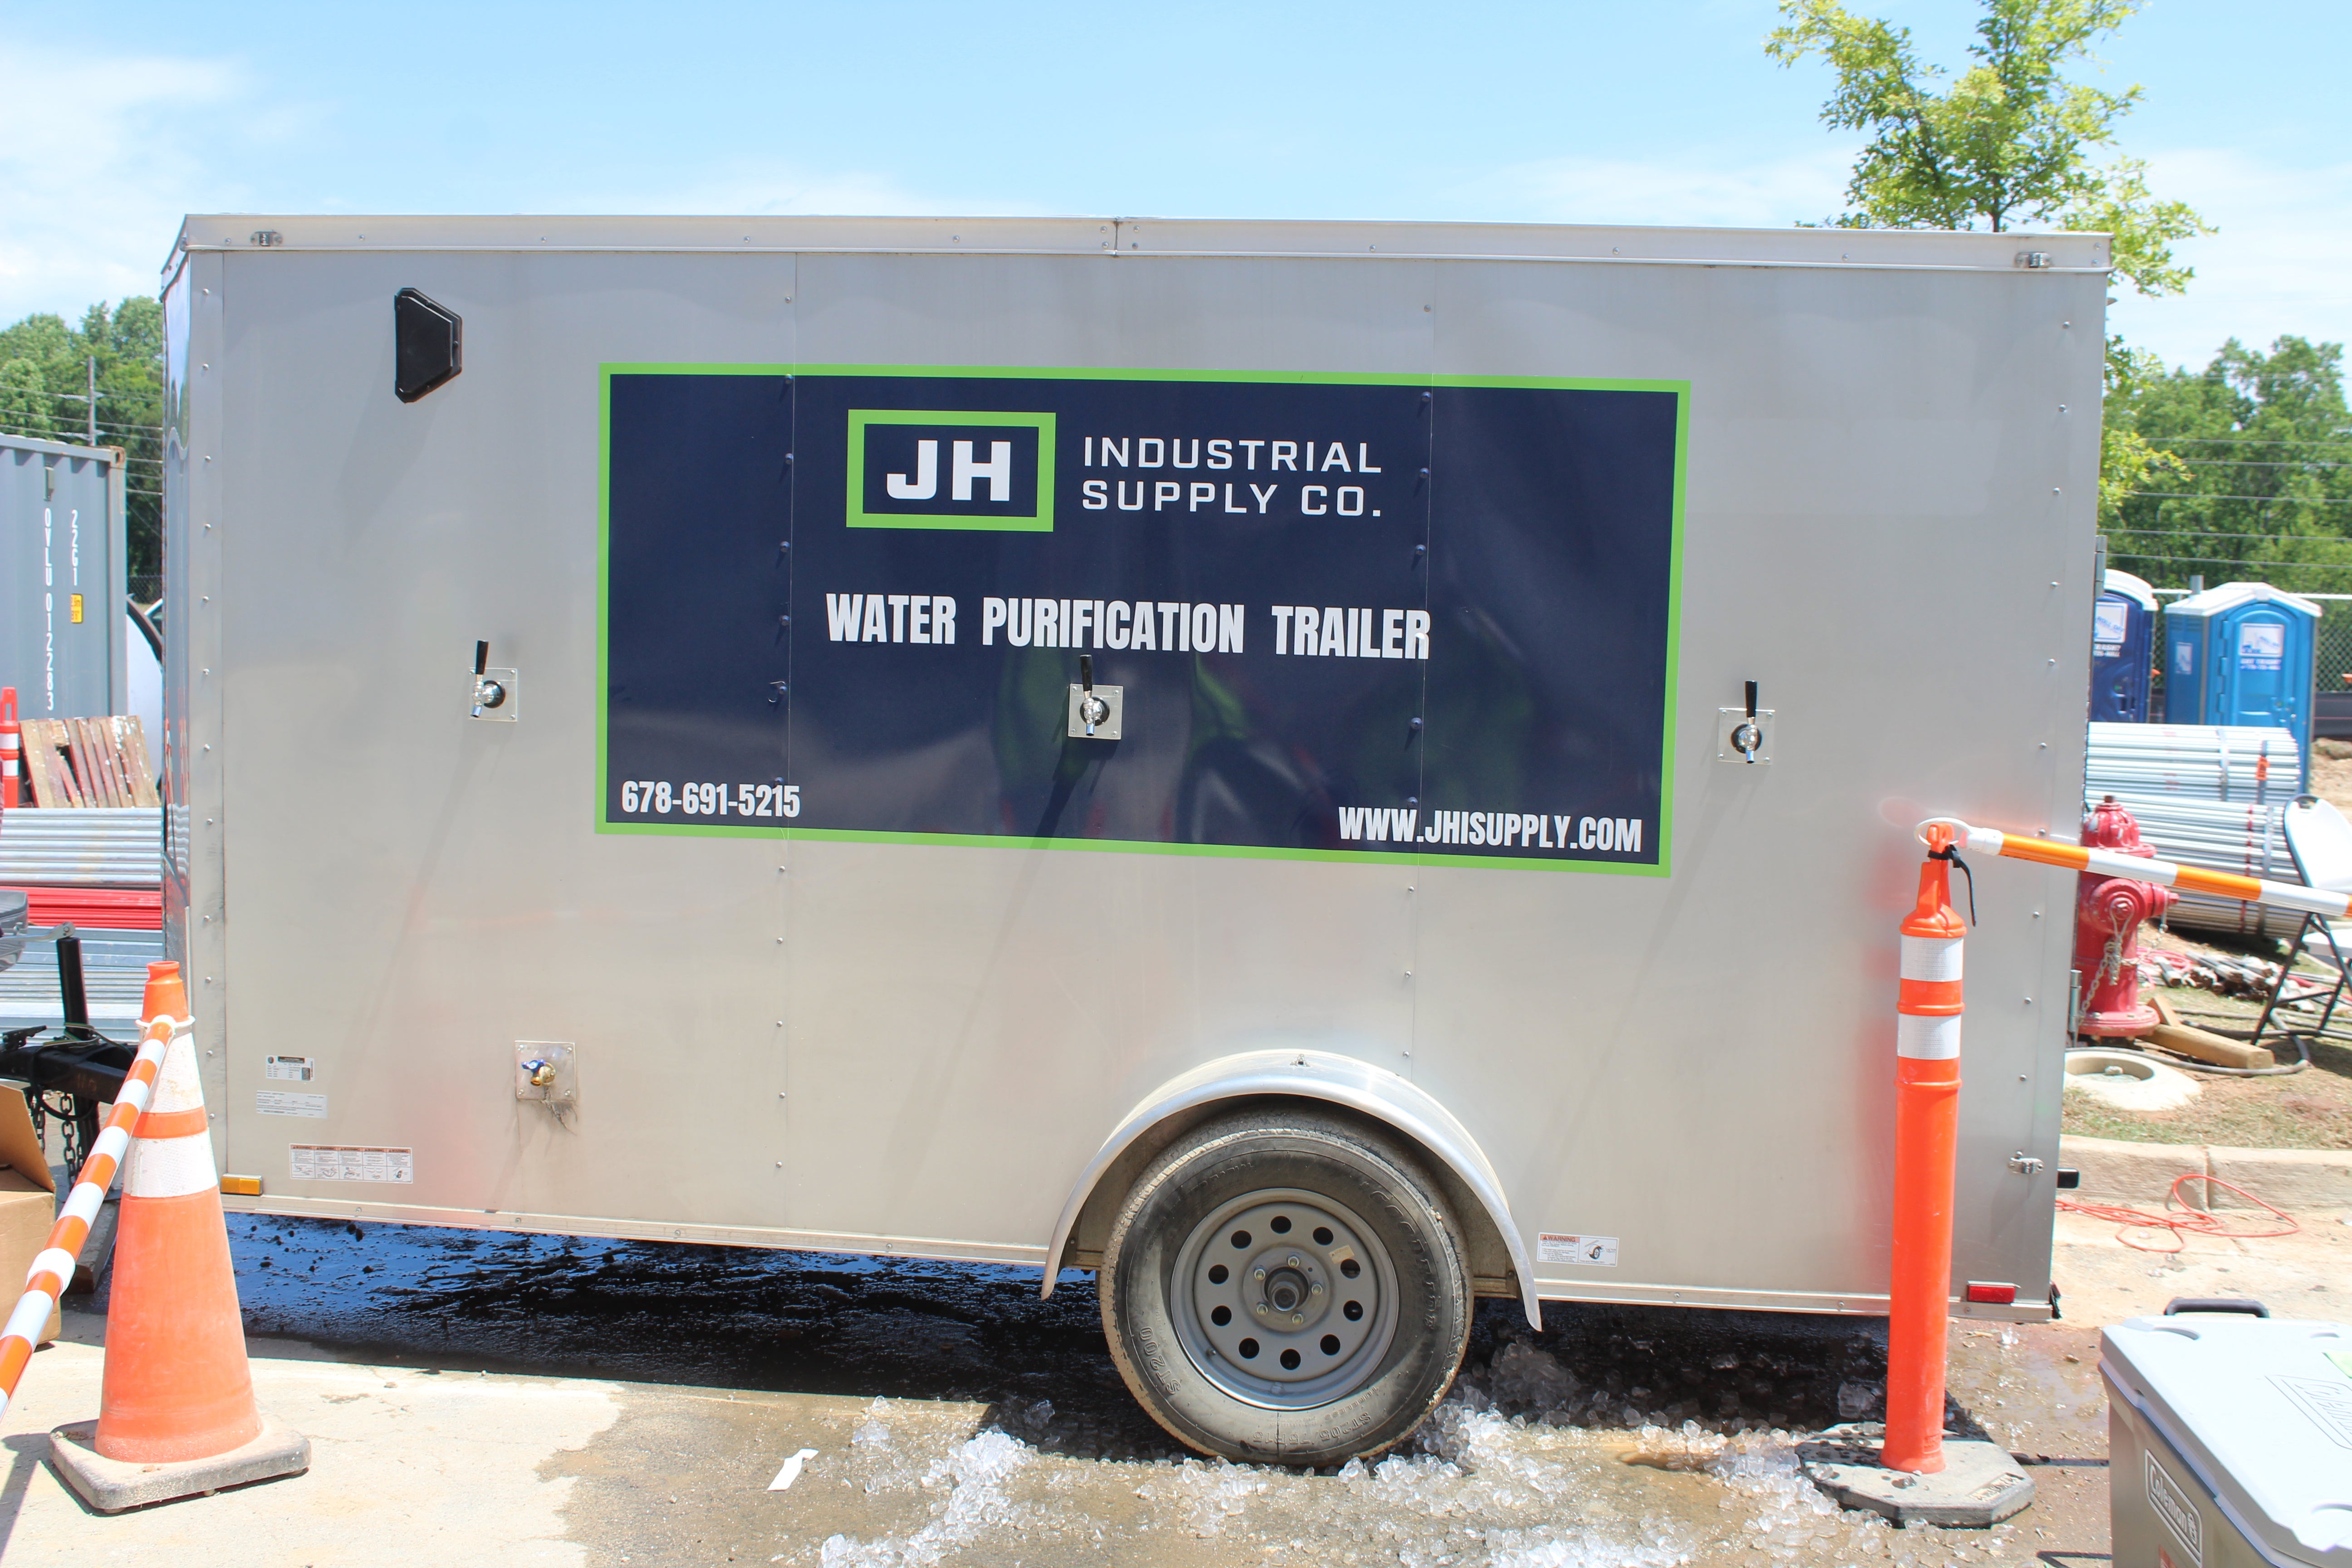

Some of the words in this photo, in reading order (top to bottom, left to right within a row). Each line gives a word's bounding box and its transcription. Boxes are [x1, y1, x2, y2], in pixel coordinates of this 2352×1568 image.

[886, 439, 1011, 502] JH
[1084, 436, 1382, 473] INDUSTRIAL
[1082, 480, 1279, 514] SUPPLY
[1301, 485, 1381, 517] CO.
[825, 593, 957, 645] WATER
[982, 597, 1245, 654] PURIFICATION
[1271, 605, 1431, 660] TRAILER
[622, 780, 801, 818] 678-691-5215
[1338, 806, 1642, 853] WWW.JHISUPPLY.COM
[1139, 1326, 1181, 1395] ST200
[2150, 1464, 2187, 1533] Coleman
